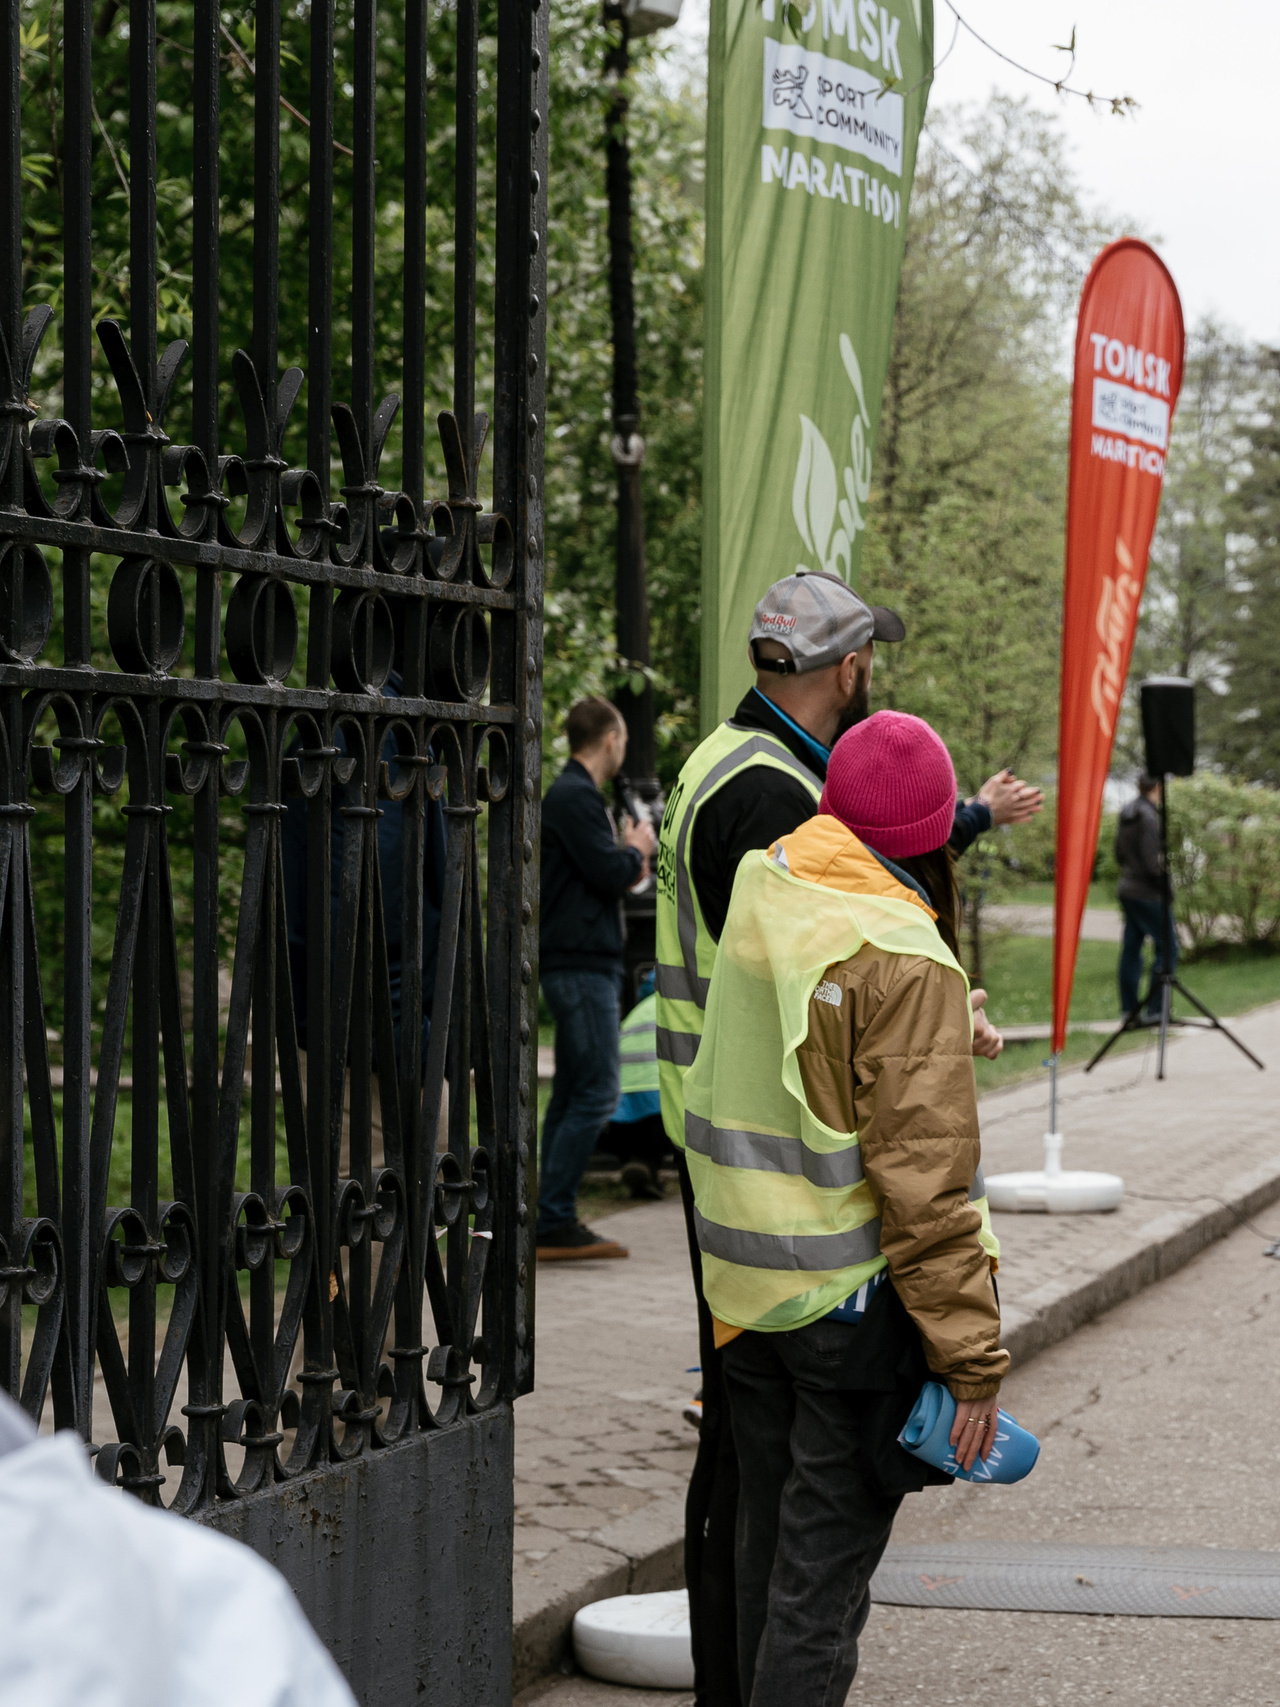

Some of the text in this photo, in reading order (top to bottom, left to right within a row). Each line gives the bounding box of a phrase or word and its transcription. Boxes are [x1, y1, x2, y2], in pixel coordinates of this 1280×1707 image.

[817, 75, 866, 110] SPORT
[816, 106, 901, 158] COMMUNITY
[1090, 332, 1171, 398] TOMSK
[777, 615, 797, 627] Bull
